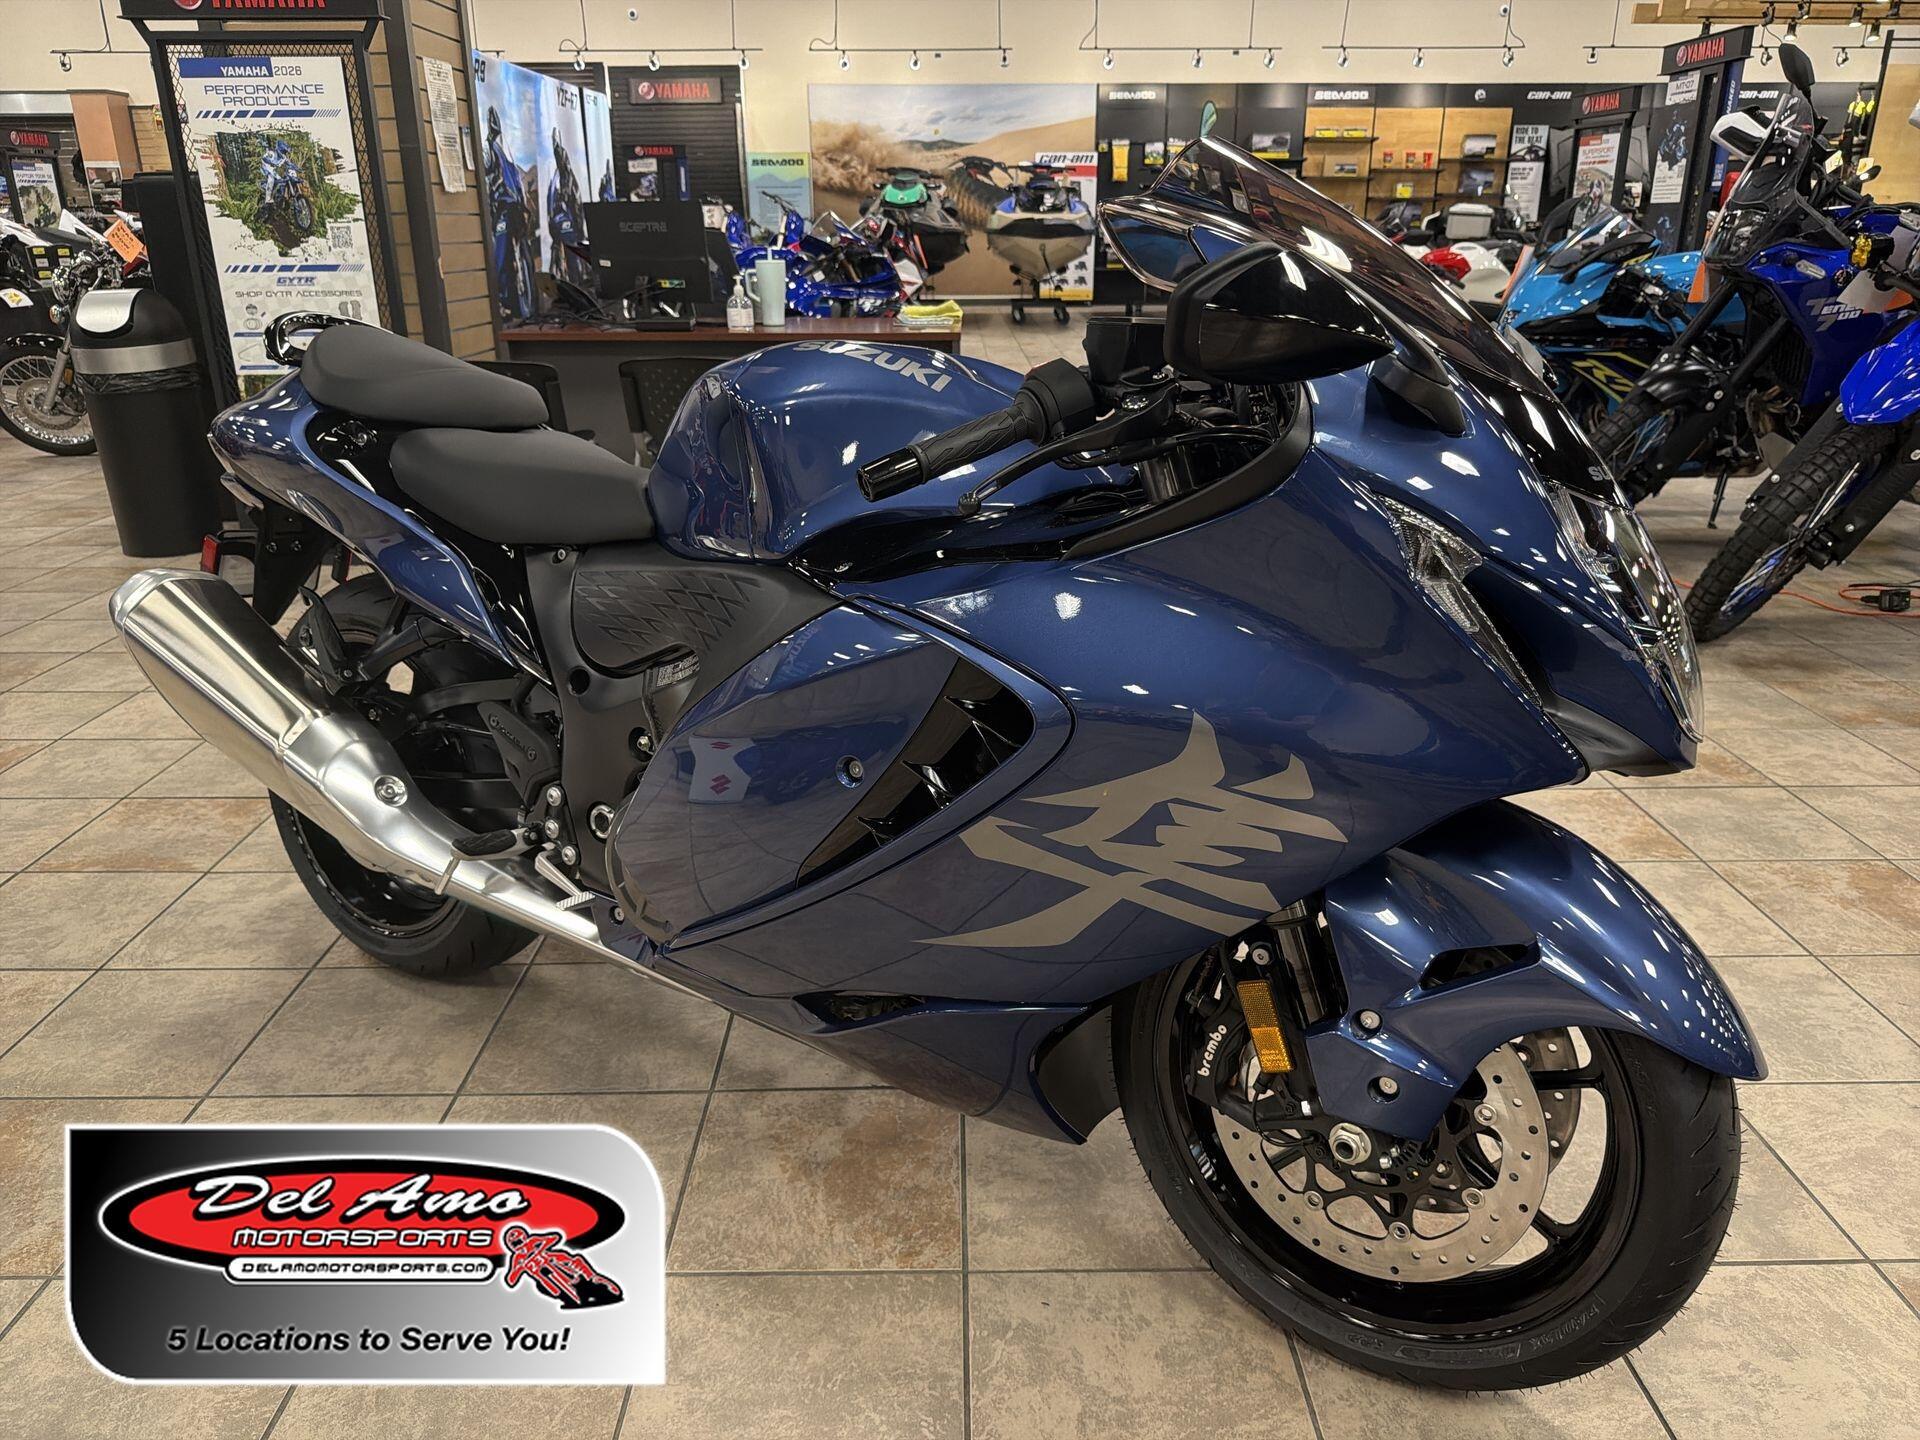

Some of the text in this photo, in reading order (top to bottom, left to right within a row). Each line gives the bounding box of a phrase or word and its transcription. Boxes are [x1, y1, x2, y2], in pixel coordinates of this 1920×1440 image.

[1687, 37, 1725, 64] YAMAHA
[220, 65, 302, 77] YAMAHA 2026
[204, 84, 325, 95] PERFORMANCE
[656, 83, 710, 99] YAMAHA
[1726, 80, 1736, 114] NAKED
[222, 96, 310, 107] PRODUCTS
[1591, 92, 1620, 113] YAMAHA
[19, 132, 49, 147] YAMAHA
[643, 147, 674, 156] YAMAHA
[276, 276, 316, 284] GYTR
[296, 290, 363, 298] ACCESSORIES
[1816, 309, 1862, 332] 700
[793, 340, 952, 393] SUZUKI
[1197, 1024, 1228, 1077] brembo
